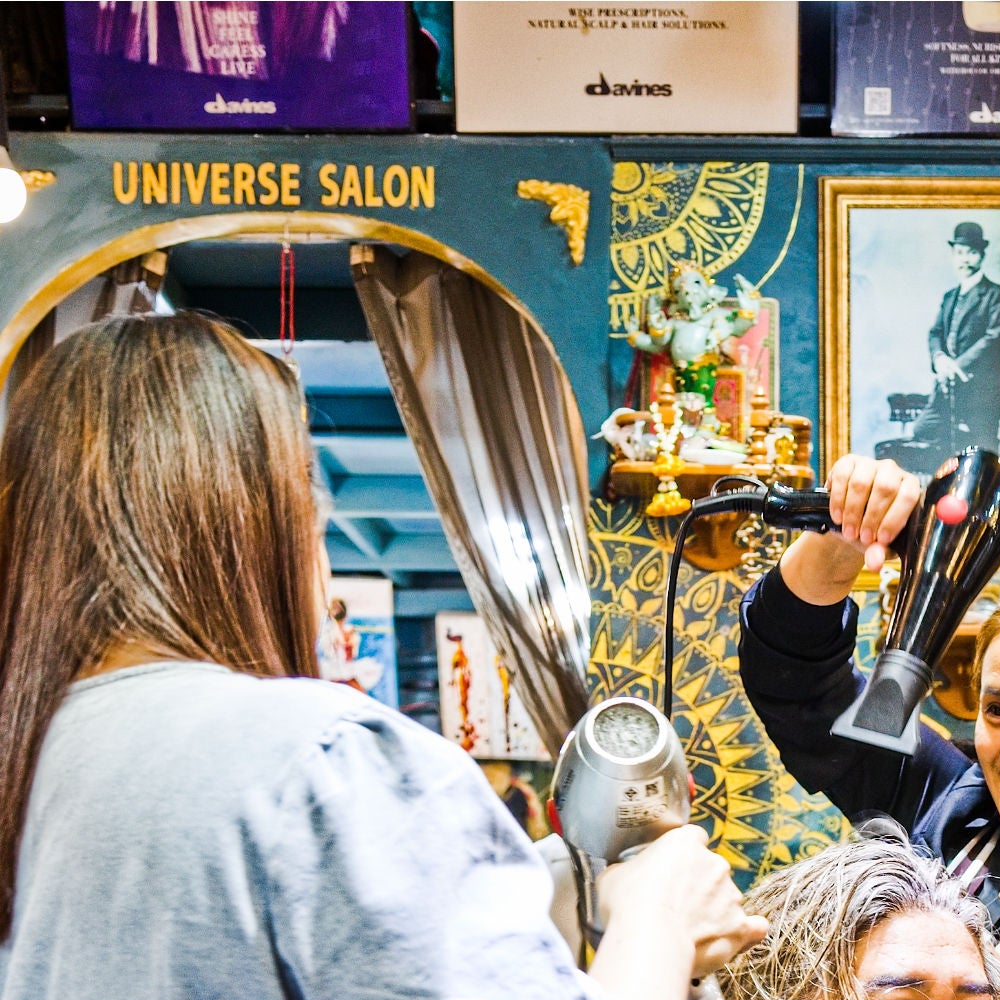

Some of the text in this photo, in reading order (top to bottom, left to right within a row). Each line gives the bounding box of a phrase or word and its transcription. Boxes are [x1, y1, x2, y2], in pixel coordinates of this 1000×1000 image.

[568, 8, 593, 17] WISE
[528, 20, 578, 29] NATURAL
[582, 20, 618, 29] SCALP
[631, 20, 658, 29] HAIR
[585, 72, 673, 97] davines
[203, 92, 277, 114] davines
[112, 161, 436, 209] UNIVERSE SALON
